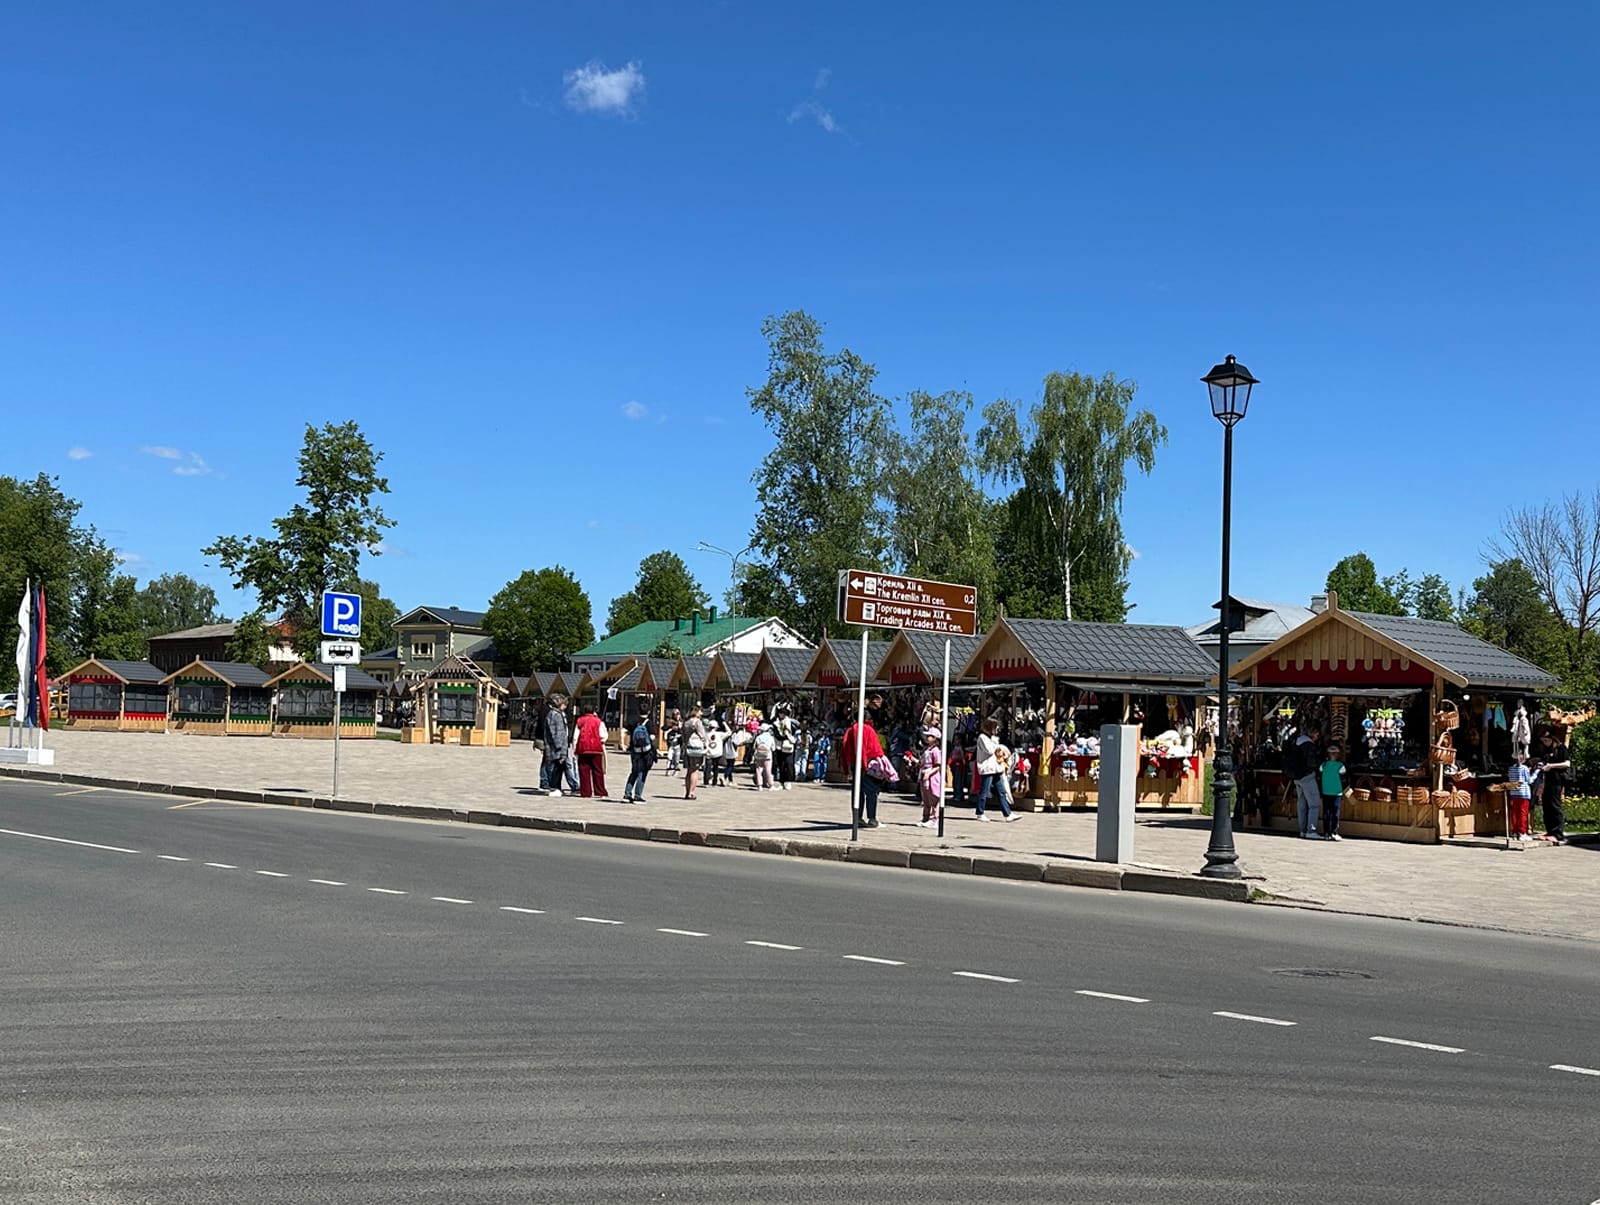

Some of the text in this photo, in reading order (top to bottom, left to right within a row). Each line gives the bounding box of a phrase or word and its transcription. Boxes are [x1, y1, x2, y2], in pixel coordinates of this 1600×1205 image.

[877, 588, 891, 599] The
[892, 590, 920, 602] Kremlin
[333, 597, 354, 631] P
[876, 602, 911, 616] Торговые
[933, 609, 945, 620] XIX
[876, 614, 903, 628] Trading
[904, 616, 934, 629] Arcades
[936, 620, 948, 631] XIX
